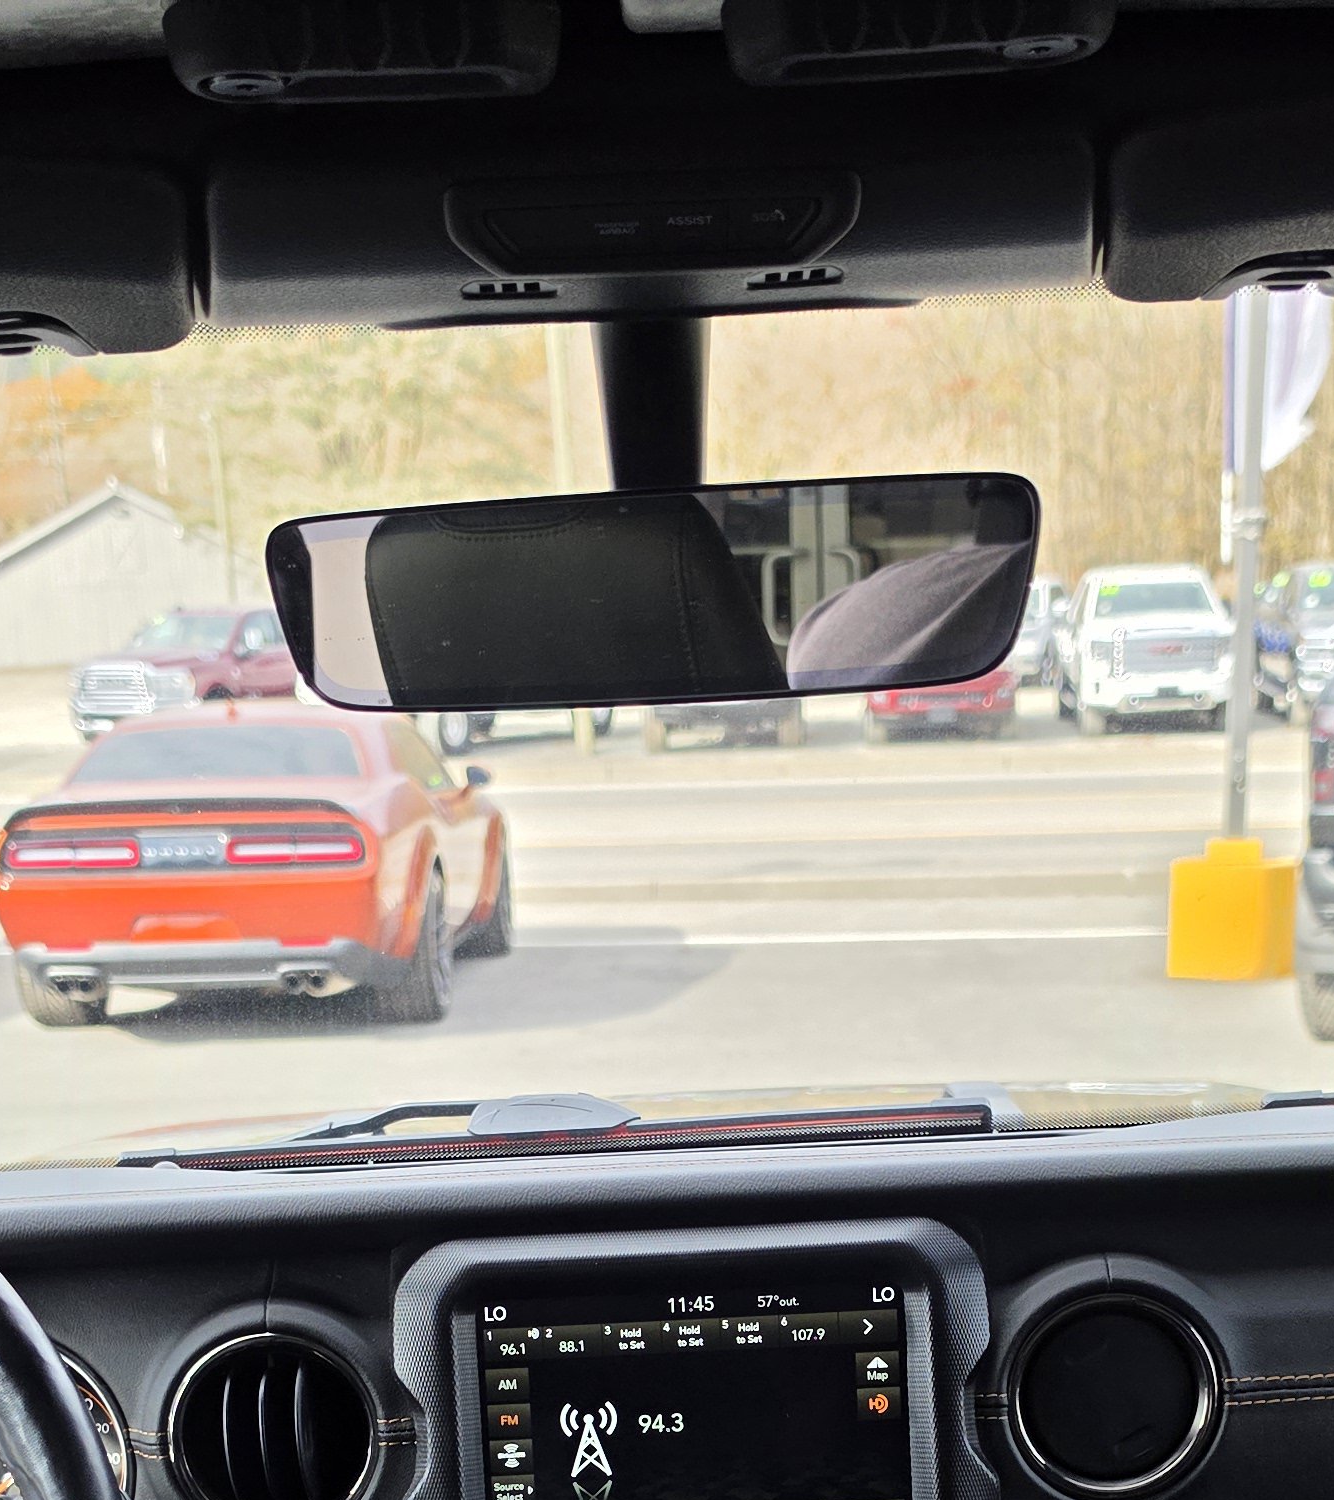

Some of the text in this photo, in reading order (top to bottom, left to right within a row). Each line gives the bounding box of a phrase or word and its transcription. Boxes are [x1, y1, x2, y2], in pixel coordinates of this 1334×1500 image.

[667, 215, 713, 226] ASSIST
[872, 1287, 895, 1302] LO
[668, 1295, 714, 1313] 11:45
[484, 1306, 506, 1321] LO
[722, 1320, 729, 1329] 5
[781, 1317, 788, 1326] 6
[604, 1326, 611, 1335] 3
[662, 1322, 670, 1332] 4
[679, 1325, 700, 1335] Hold
[738, 1322, 759, 1332] Hold
[487, 1331, 493, 1341] 1
[545, 1329, 553, 1338] 2
[620, 1328, 642, 1338] Hold
[791, 1328, 826, 1341] 107.9
[677, 1338, 705, 1347] to Set
[736, 1334, 763, 1344] to Set
[500, 1343, 526, 1355] 96.1
[559, 1340, 585, 1352] 88.1
[619, 1341, 645, 1350] to Set
[867, 1371, 888, 1381] Map
[498, 1379, 517, 1390] AM
[501, 1415, 518, 1425] FM
[638, 1413, 684, 1434] 94.3
[494, 1482, 524, 1492] Source
